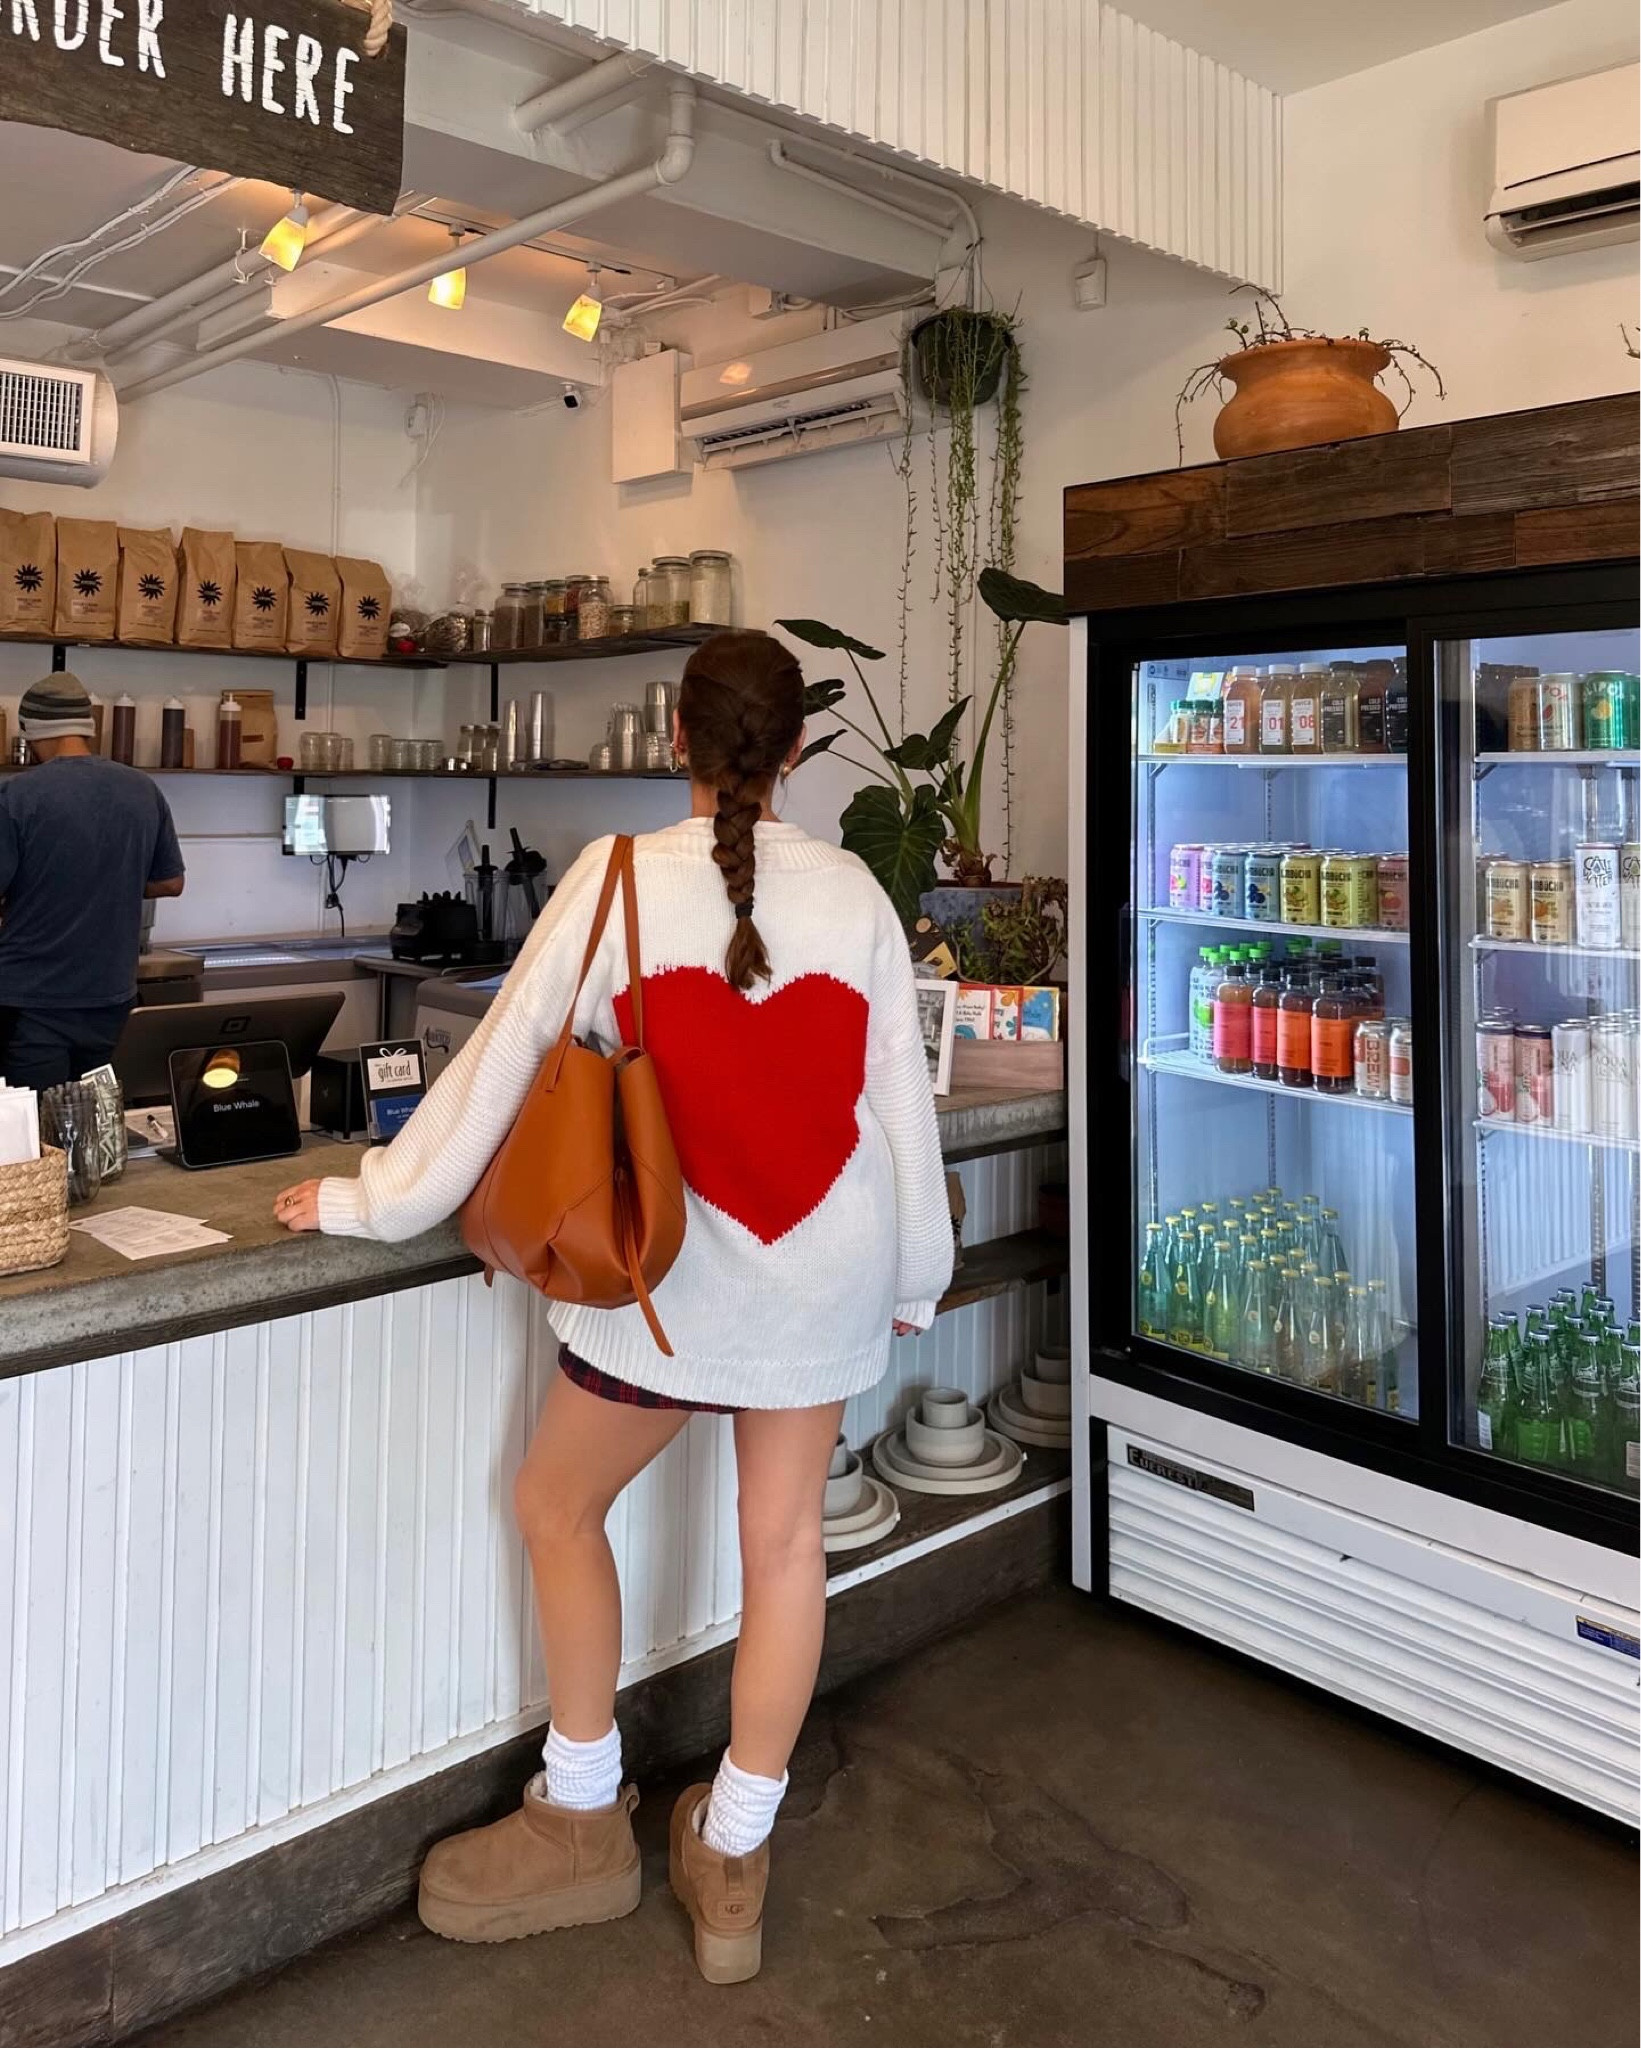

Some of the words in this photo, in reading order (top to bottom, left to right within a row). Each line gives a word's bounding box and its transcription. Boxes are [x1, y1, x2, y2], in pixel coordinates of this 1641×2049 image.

[0, 0, 166, 78] RDER
[221, 13, 360, 135] HERE
[1268, 716, 1285, 731] 01
[1622, 855, 1641, 872] CA
[377, 1062, 394, 1083] gift
[395, 1060, 411, 1077] card
[1366, 1038, 1380, 1090] BREW
[213, 1103, 232, 1113] Blue
[233, 1099, 260, 1110] Whale
